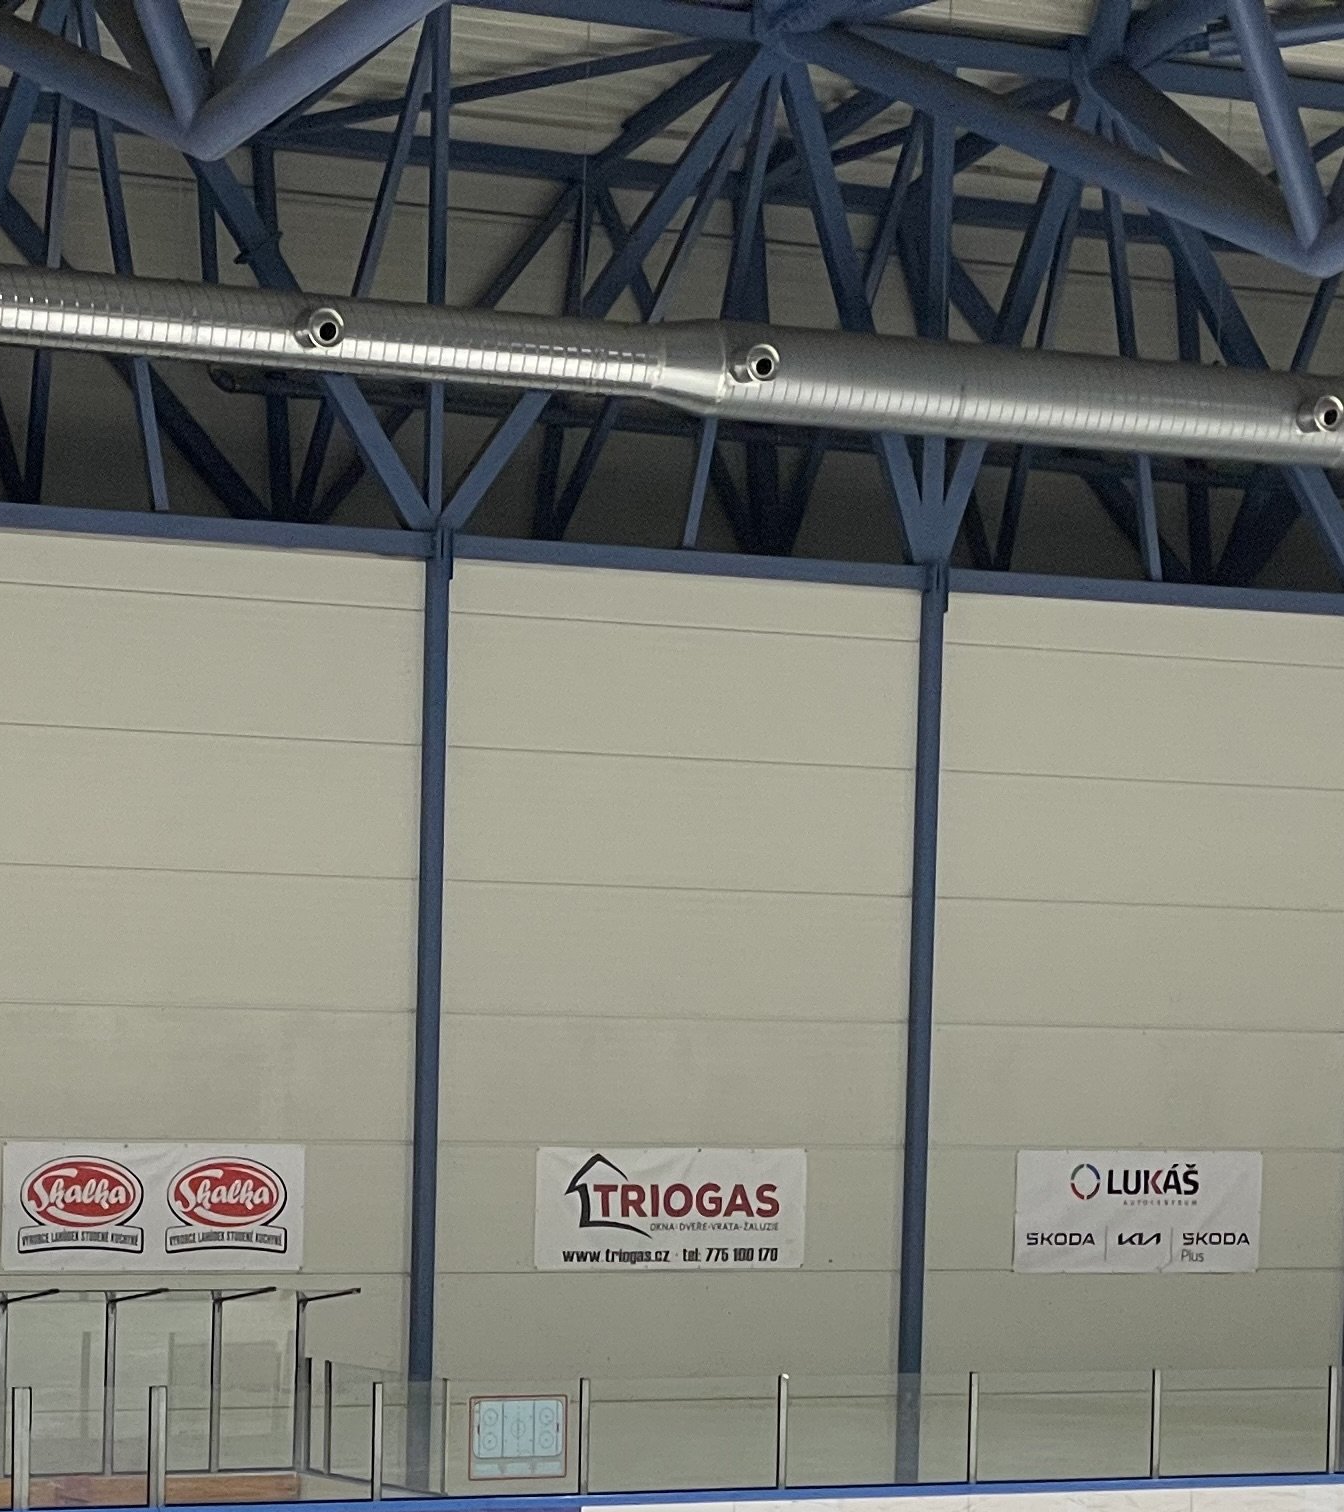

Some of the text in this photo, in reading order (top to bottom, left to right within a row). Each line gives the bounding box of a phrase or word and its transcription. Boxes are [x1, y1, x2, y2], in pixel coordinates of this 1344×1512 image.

[29, 1168, 126, 1211] Skalka
[175, 1169, 270, 1212] Skalka
[1107, 1163, 1200, 1195] LUKÁŠ
[593, 1182, 780, 1218] TRIOGAS
[562, 1248, 670, 1264] www.triogas.cz
[1181, 1249, 1205, 1263] Plus
